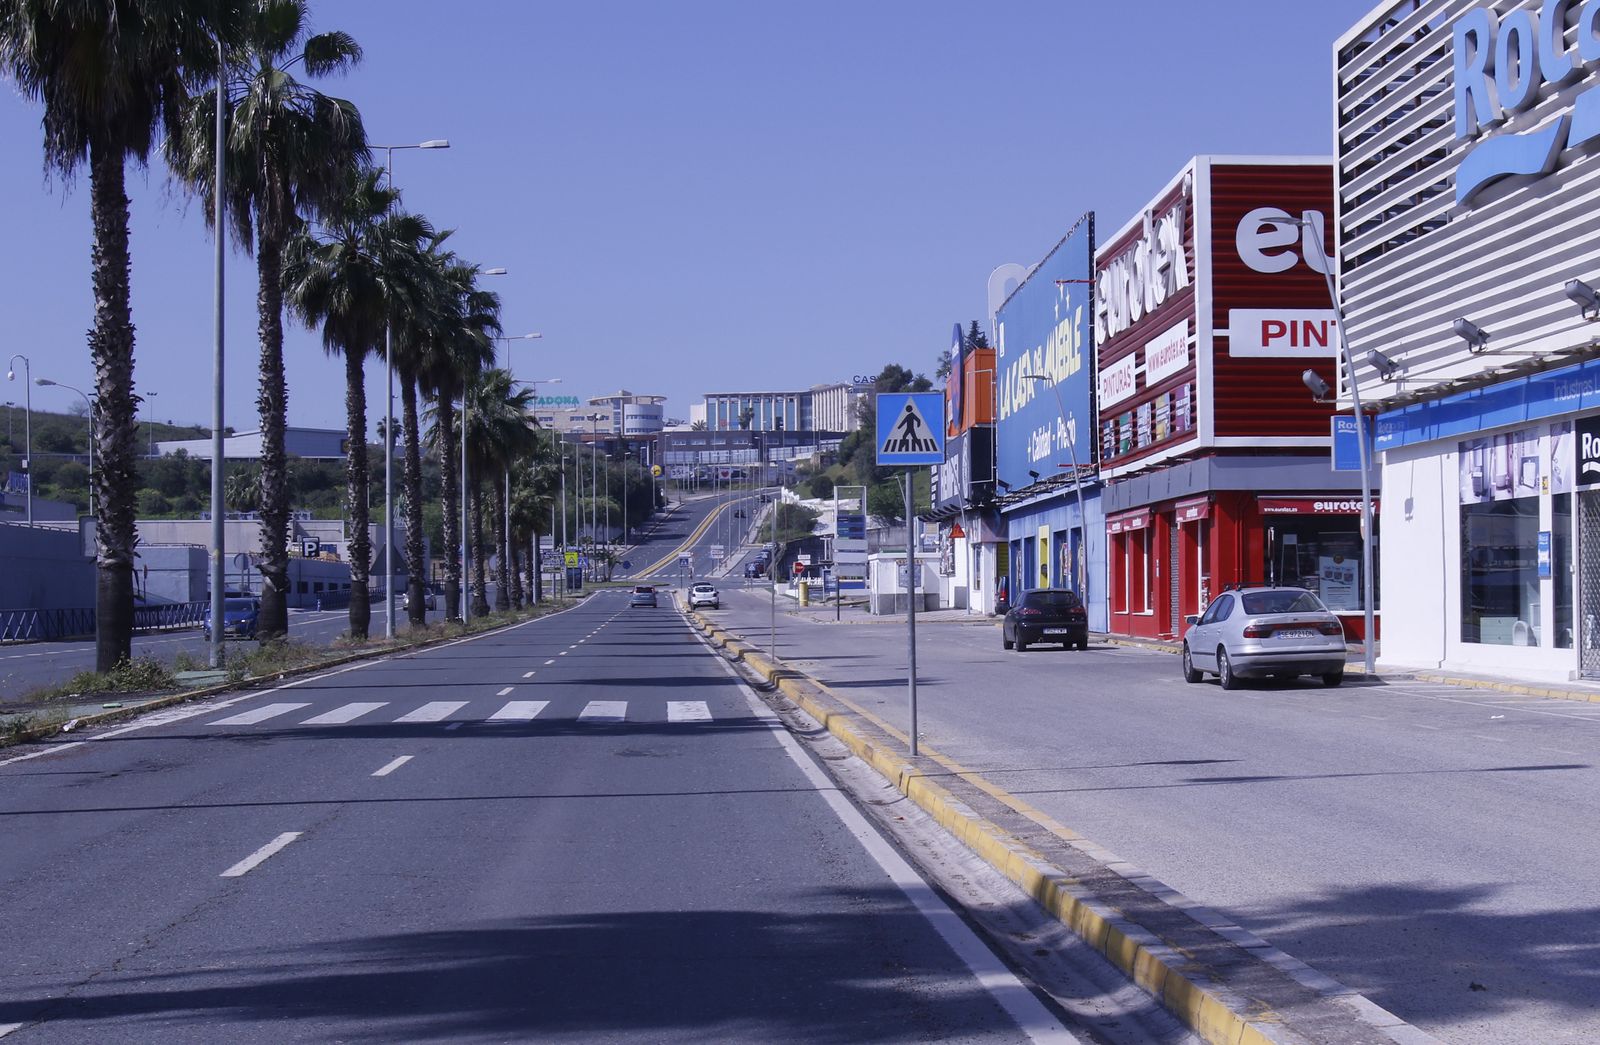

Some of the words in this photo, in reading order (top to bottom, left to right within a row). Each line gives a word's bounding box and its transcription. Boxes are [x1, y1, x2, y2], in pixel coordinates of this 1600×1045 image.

[1095, 203, 1190, 345] eurotex
[1001, 368, 1010, 421] LA
[1012, 348, 1035, 413] CASA
[1044, 305, 1082, 391] MUEBLE
[1103, 363, 1131, 401] PINTURAS
